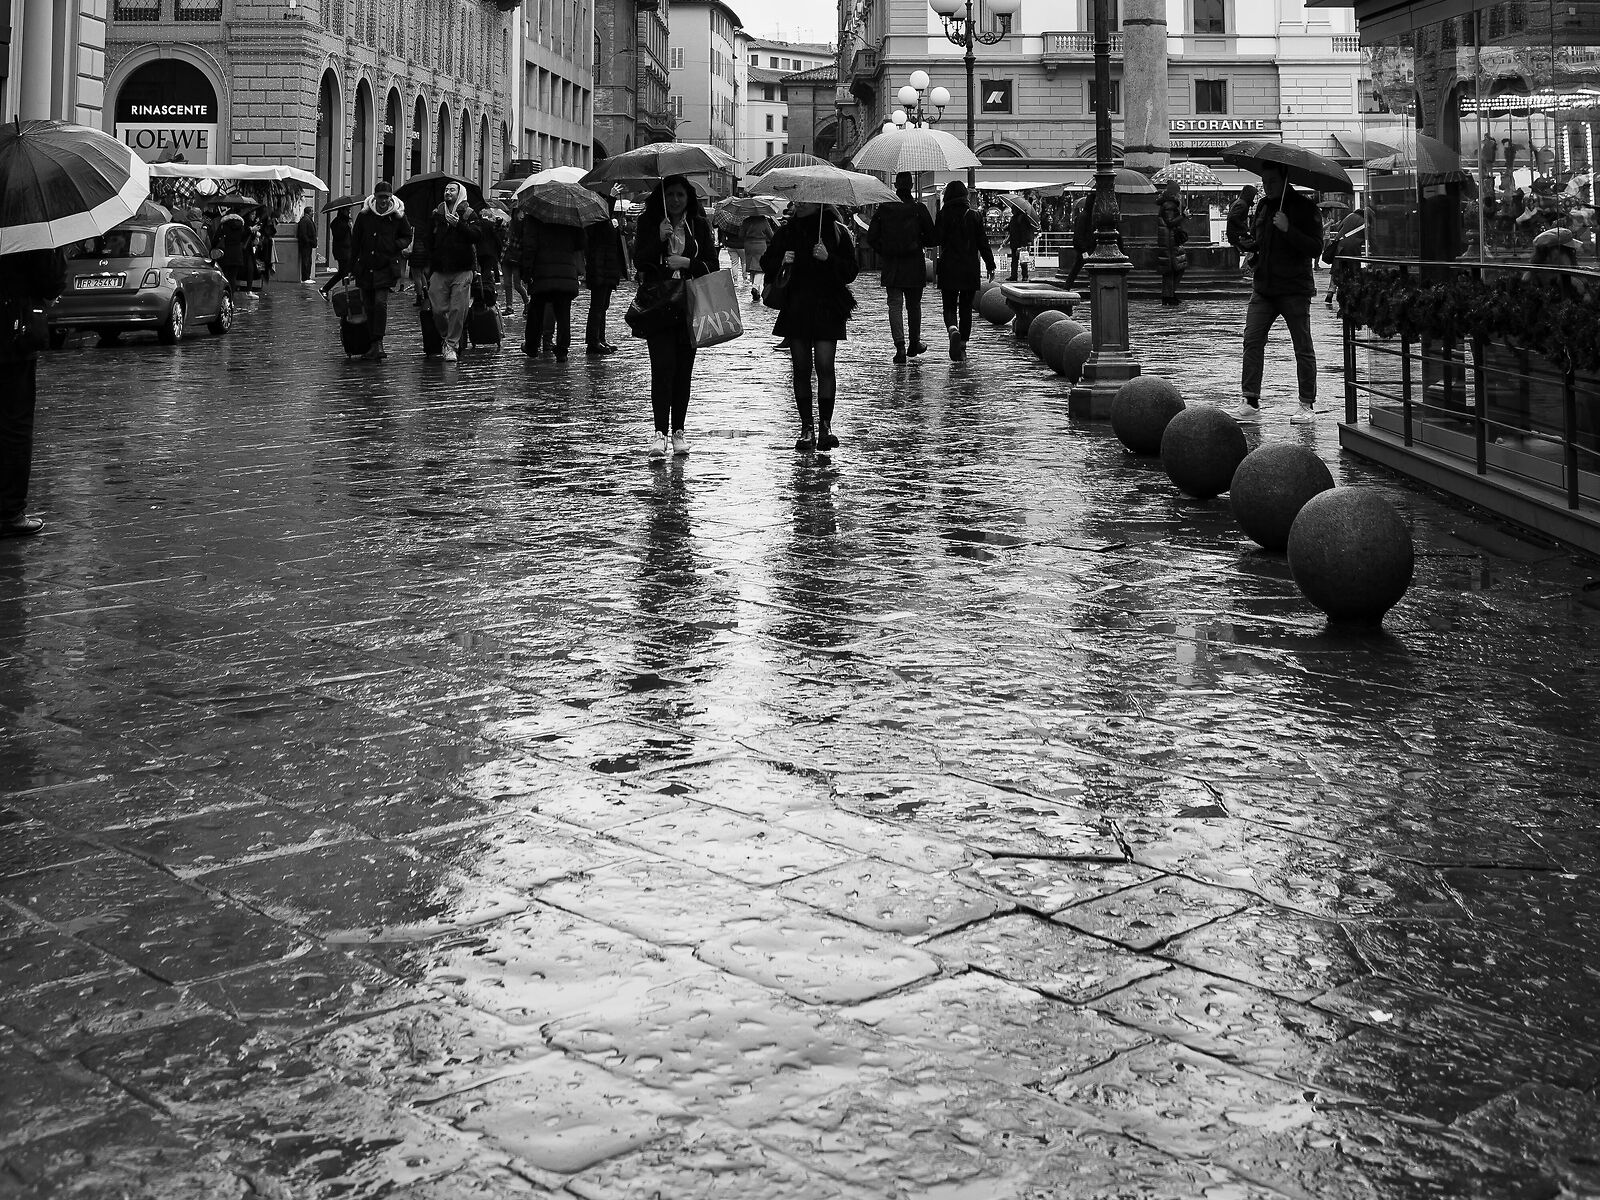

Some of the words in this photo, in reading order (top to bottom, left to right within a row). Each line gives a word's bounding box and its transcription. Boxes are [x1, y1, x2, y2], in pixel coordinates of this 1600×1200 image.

[131, 105, 208, 115] RINASCENTE
[1171, 120, 1264, 130] ISTORANTE
[125, 129, 209, 149] LOEWE
[692, 308, 741, 342] ZARA
